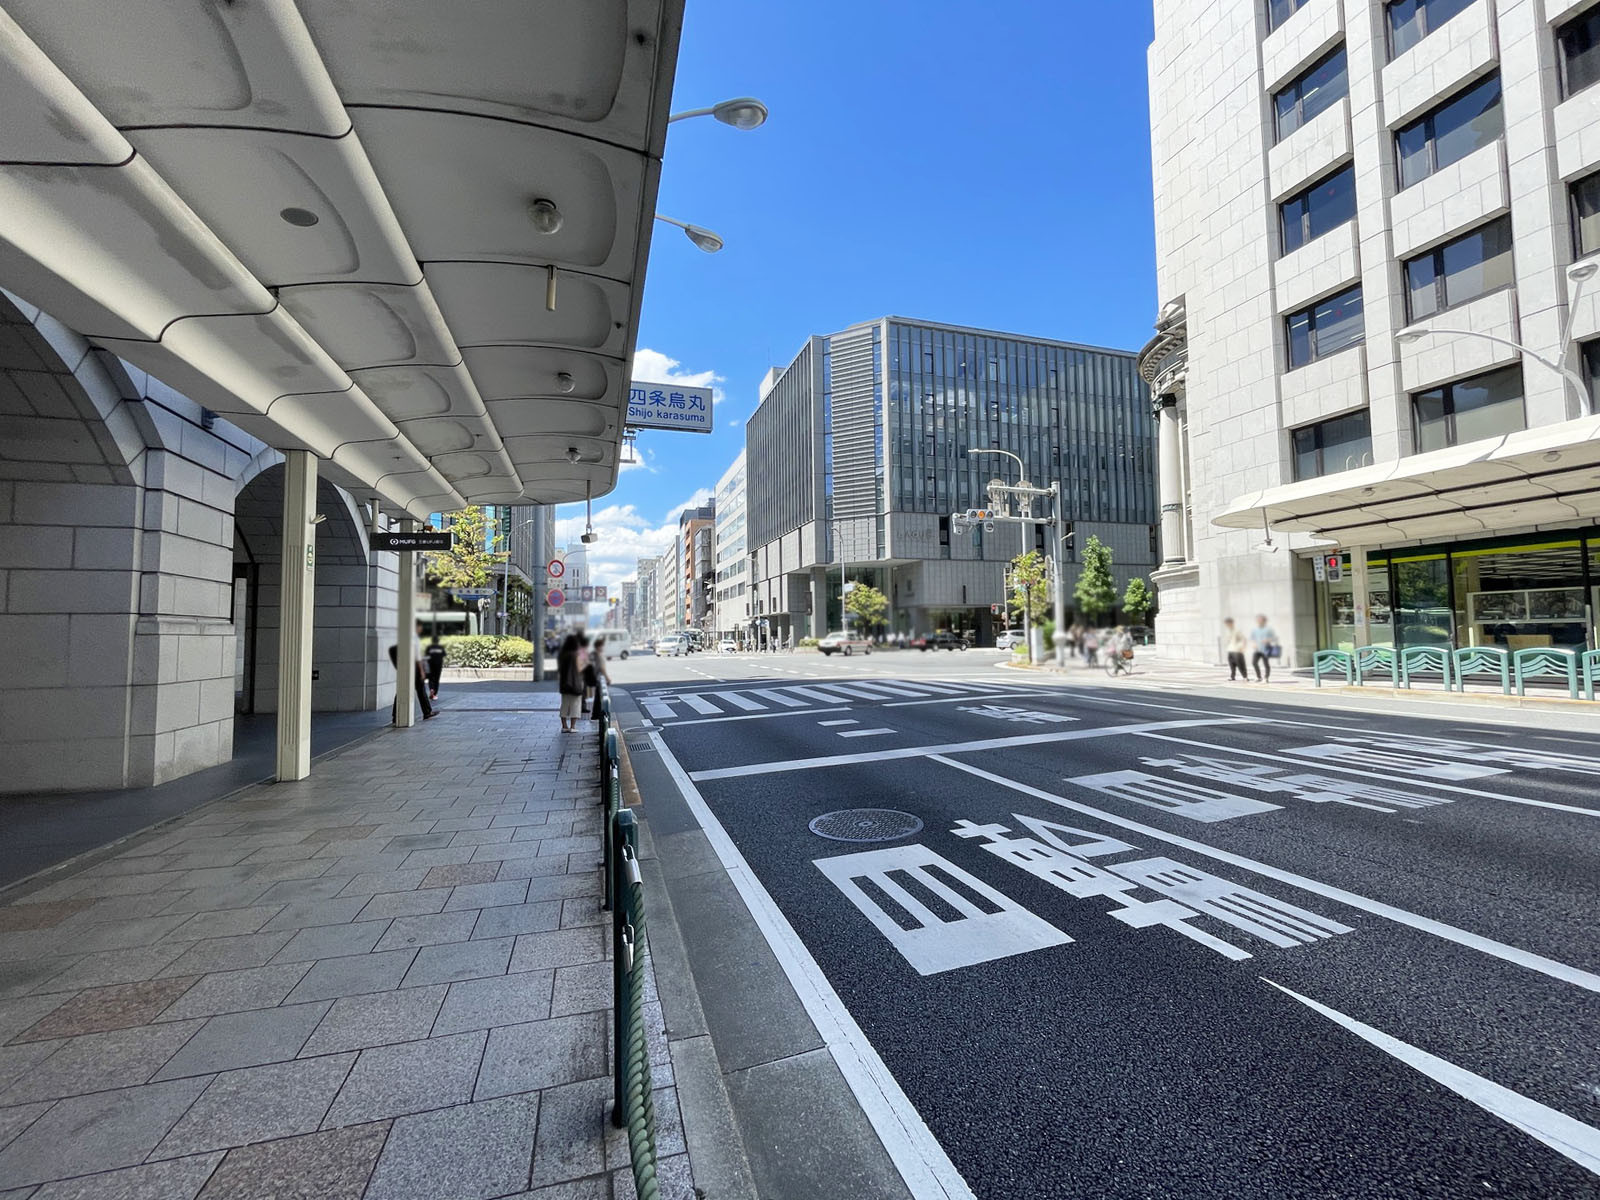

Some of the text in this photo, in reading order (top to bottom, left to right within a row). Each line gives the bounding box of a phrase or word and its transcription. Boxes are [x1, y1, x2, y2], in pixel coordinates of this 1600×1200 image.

[628, 389, 706, 411] 四条烏丸
[628, 407, 705, 422] Shijo karasuma
